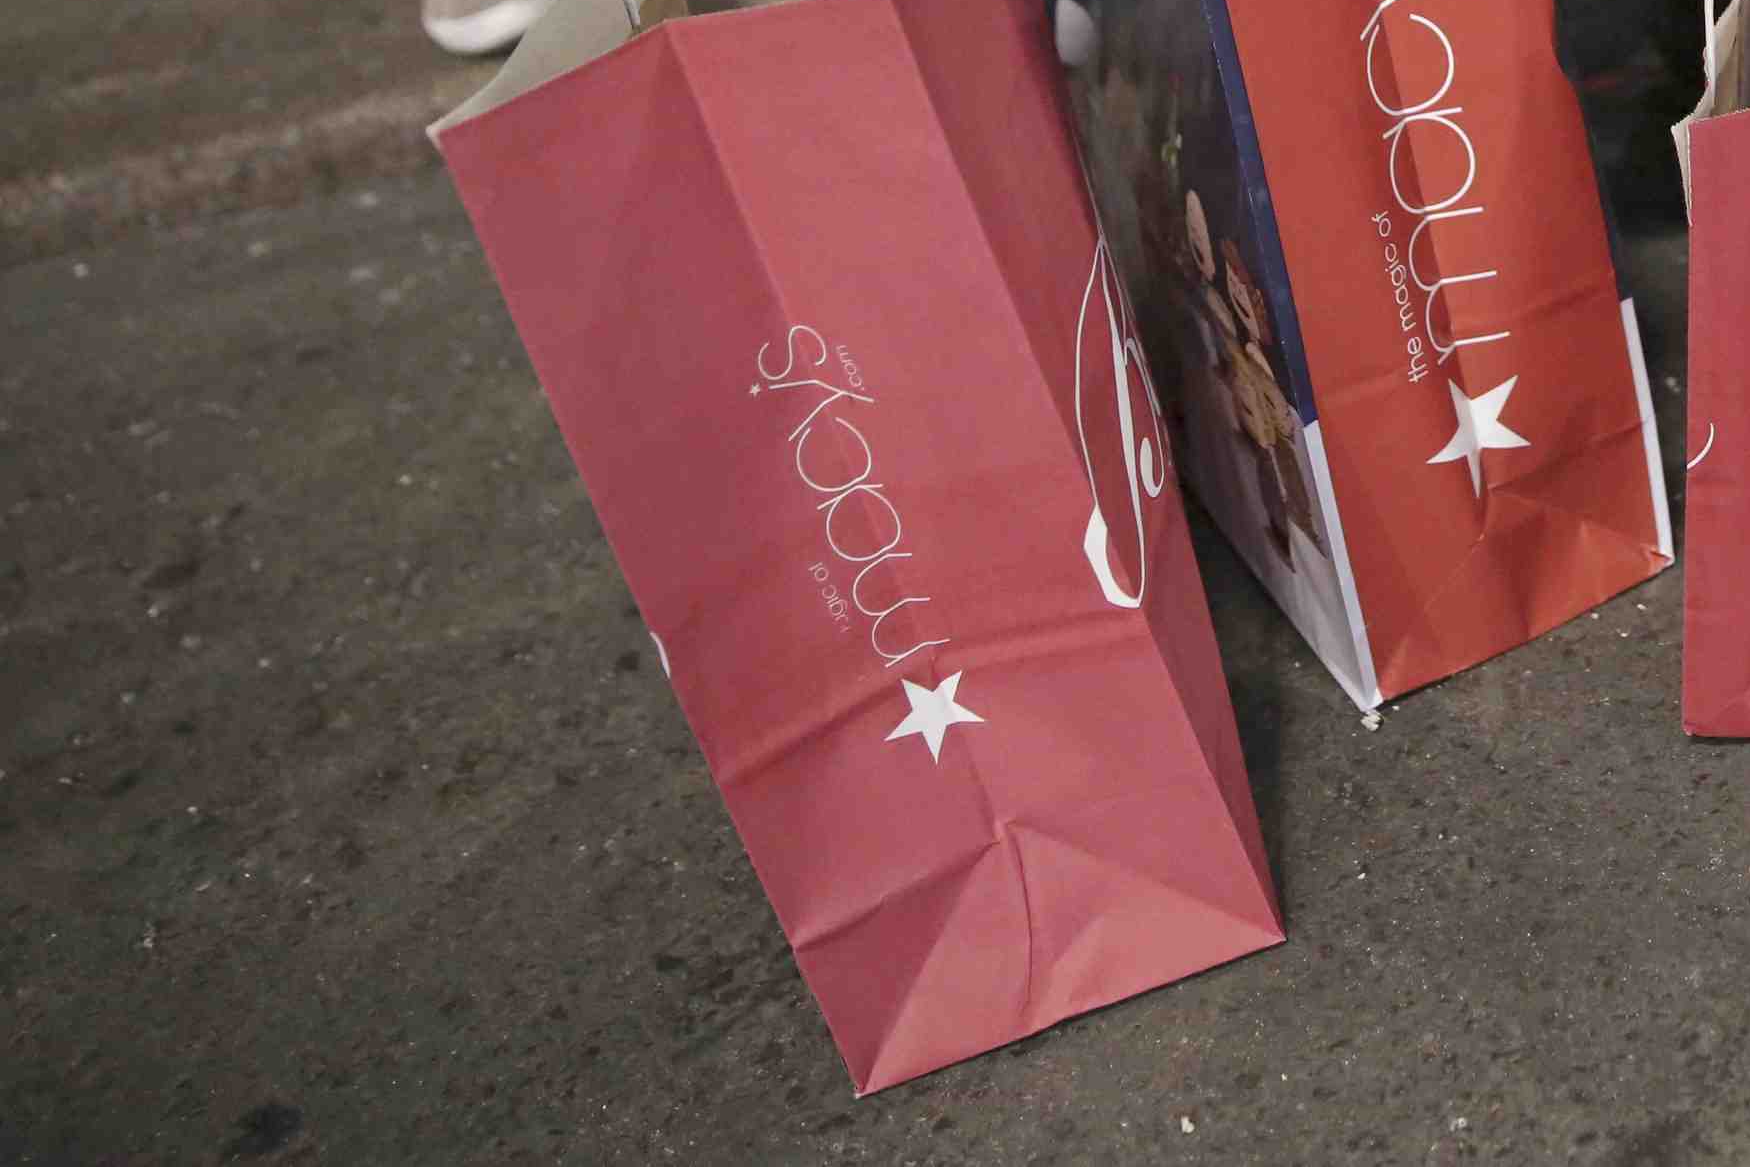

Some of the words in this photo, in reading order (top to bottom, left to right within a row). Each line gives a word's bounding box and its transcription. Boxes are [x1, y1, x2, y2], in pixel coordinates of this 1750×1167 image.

[1371, 211, 1391, 237] of
[1384, 243, 1416, 332] magic
[835, 344, 865, 391] .com
[1408, 336, 1429, 383] the
[748, 324, 950, 668] macy's
